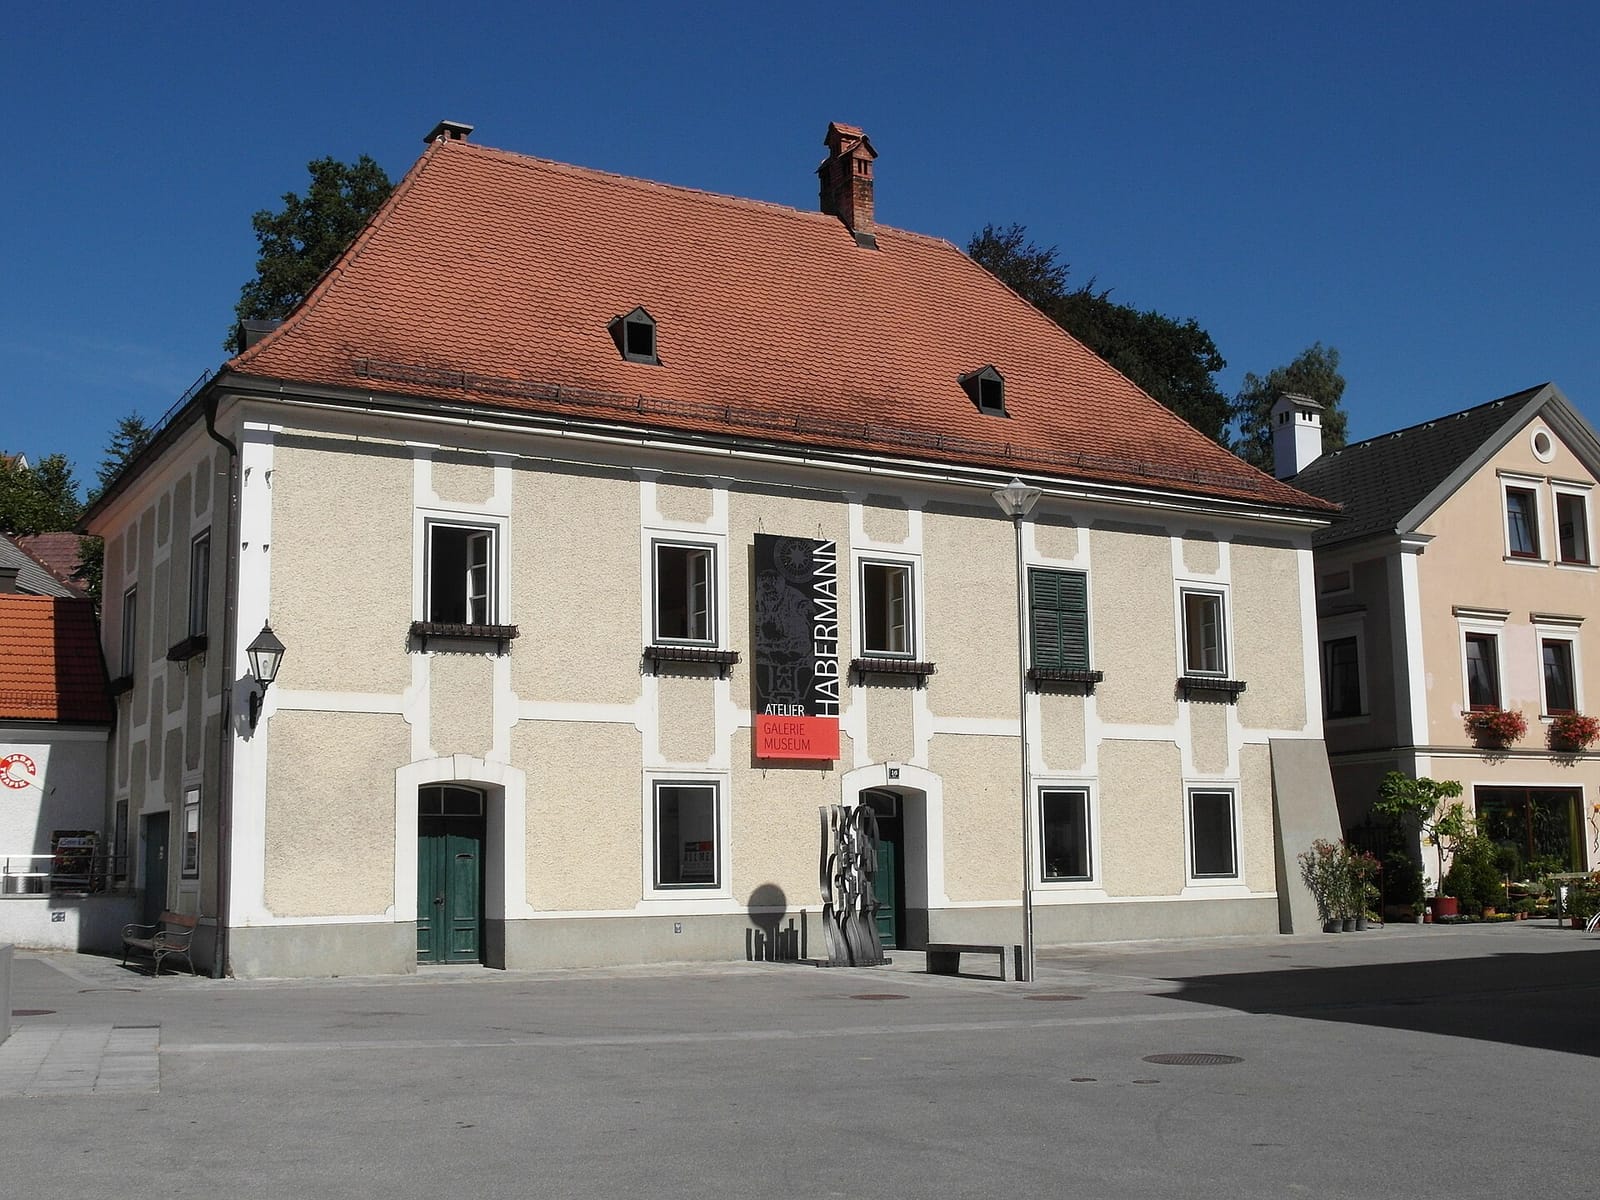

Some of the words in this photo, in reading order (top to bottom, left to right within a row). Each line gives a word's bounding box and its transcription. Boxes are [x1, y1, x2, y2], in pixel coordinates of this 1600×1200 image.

[812, 538, 839, 717] HABERMANN
[764, 703, 805, 717] ATELIER
[764, 722, 805, 735] GALERIE
[764, 737, 811, 751] MUSEUM
[6, 755, 35, 771] TABAK
[0, 766, 27, 787] TRAFIK
